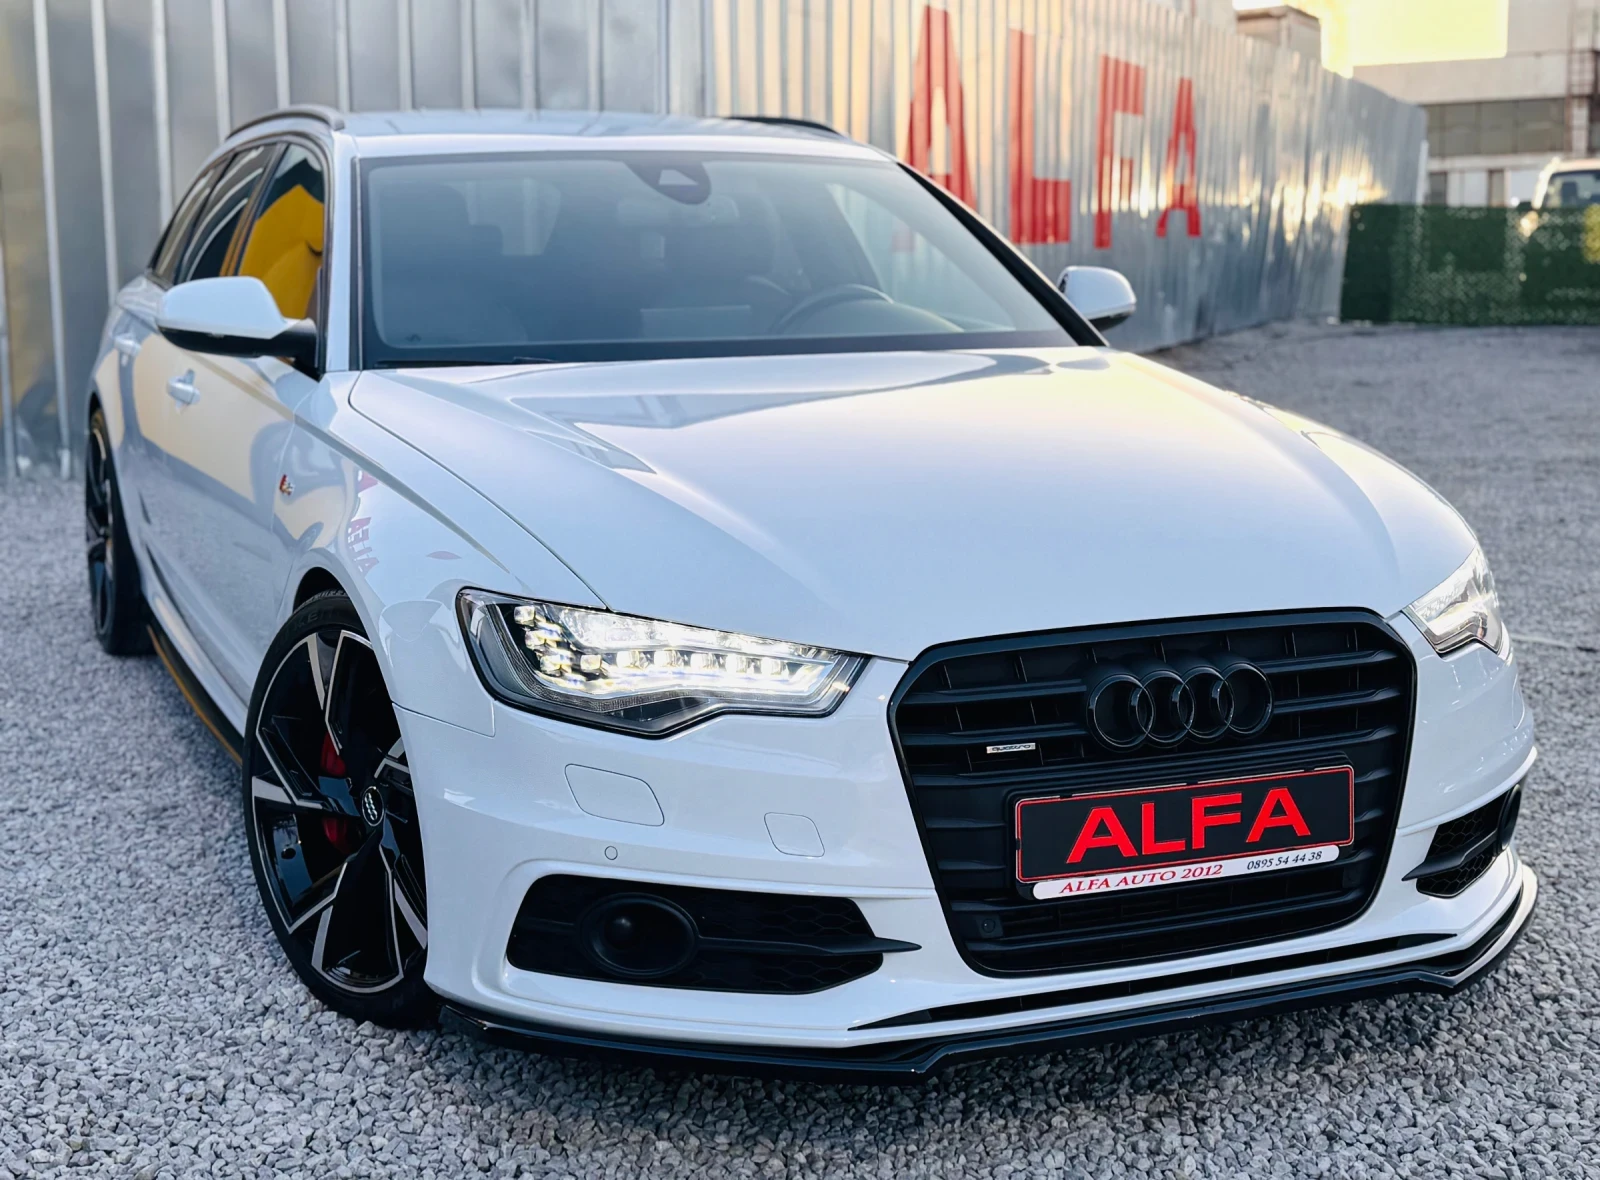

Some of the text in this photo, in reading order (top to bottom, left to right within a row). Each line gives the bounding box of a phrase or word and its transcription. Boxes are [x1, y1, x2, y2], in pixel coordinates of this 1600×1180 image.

[905, 5, 1202, 249] ALFA
[1066, 787, 1311, 864] ALFA
[1059, 850, 1323, 894] ALFA AUTO 2012 0895 54 44 38
